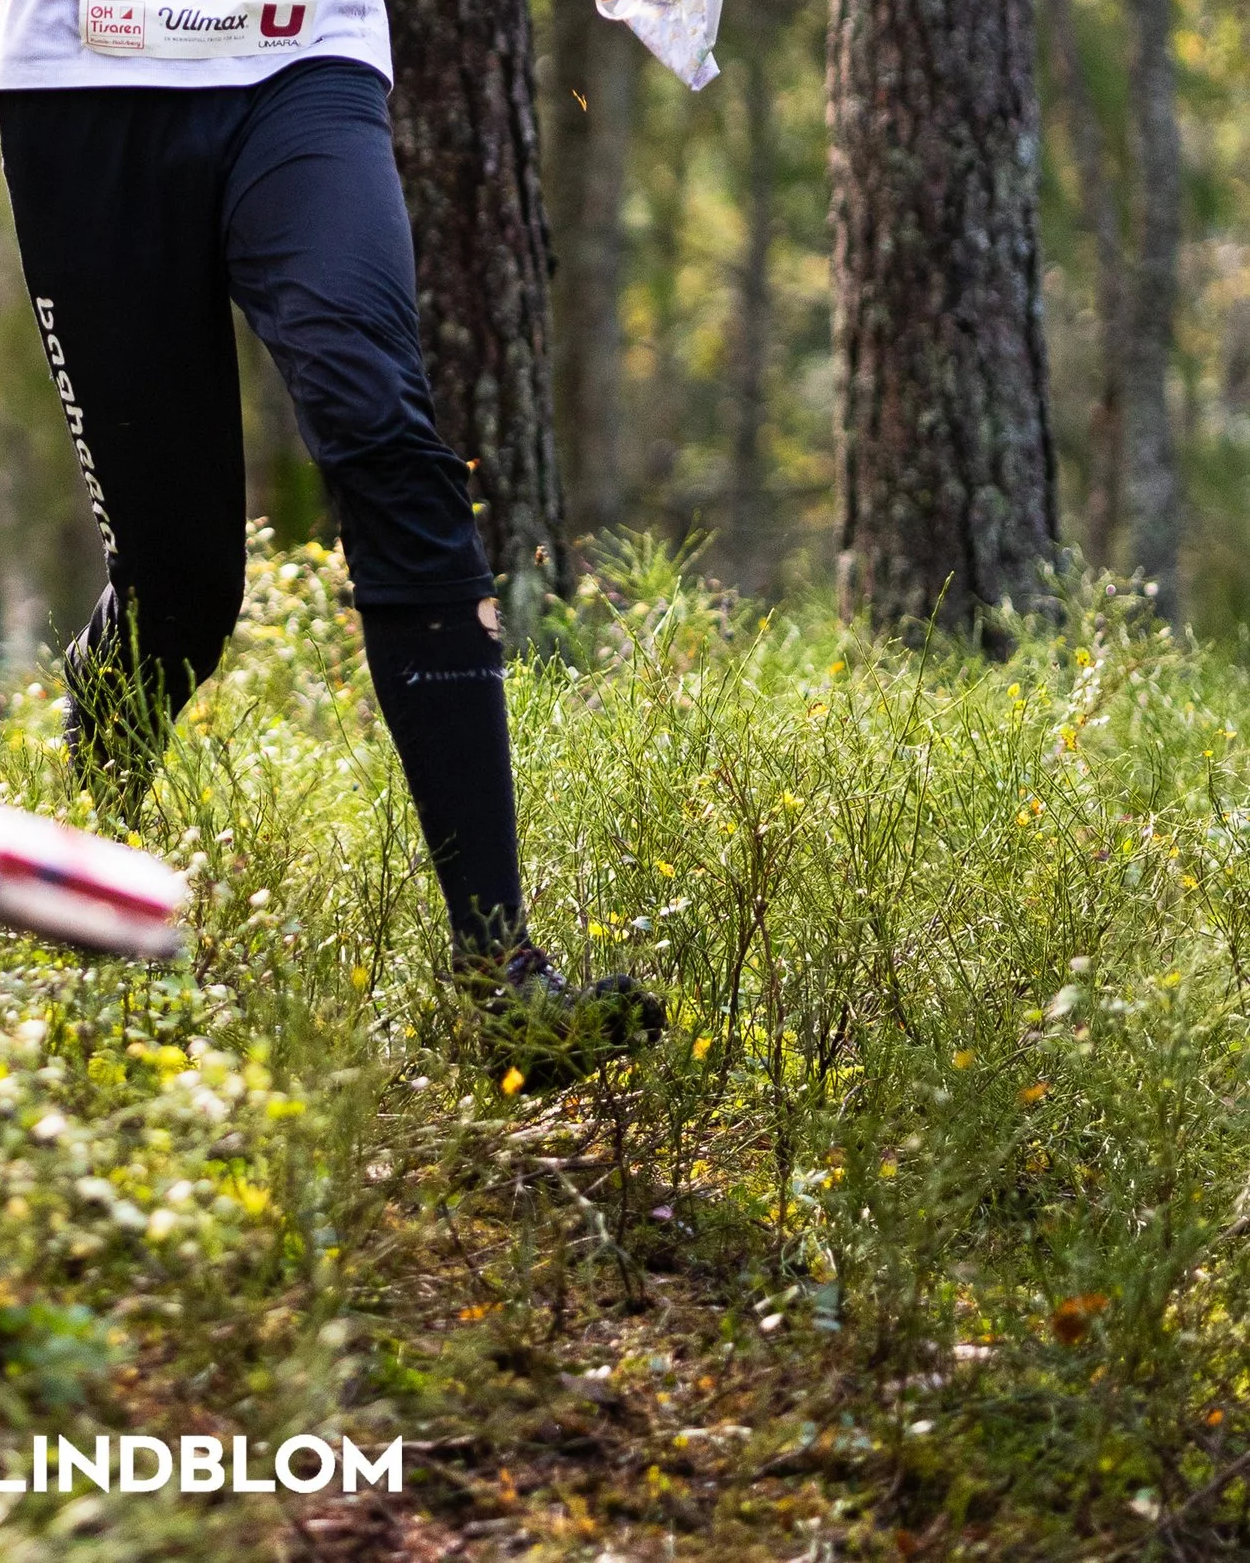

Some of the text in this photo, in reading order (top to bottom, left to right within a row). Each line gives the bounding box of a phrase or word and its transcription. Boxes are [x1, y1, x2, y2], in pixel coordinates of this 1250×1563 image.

[158, 7, 248, 31] Ullmax
[90, 20, 141, 35] Tisaren
[258, 39, 300, 48] UMARA
